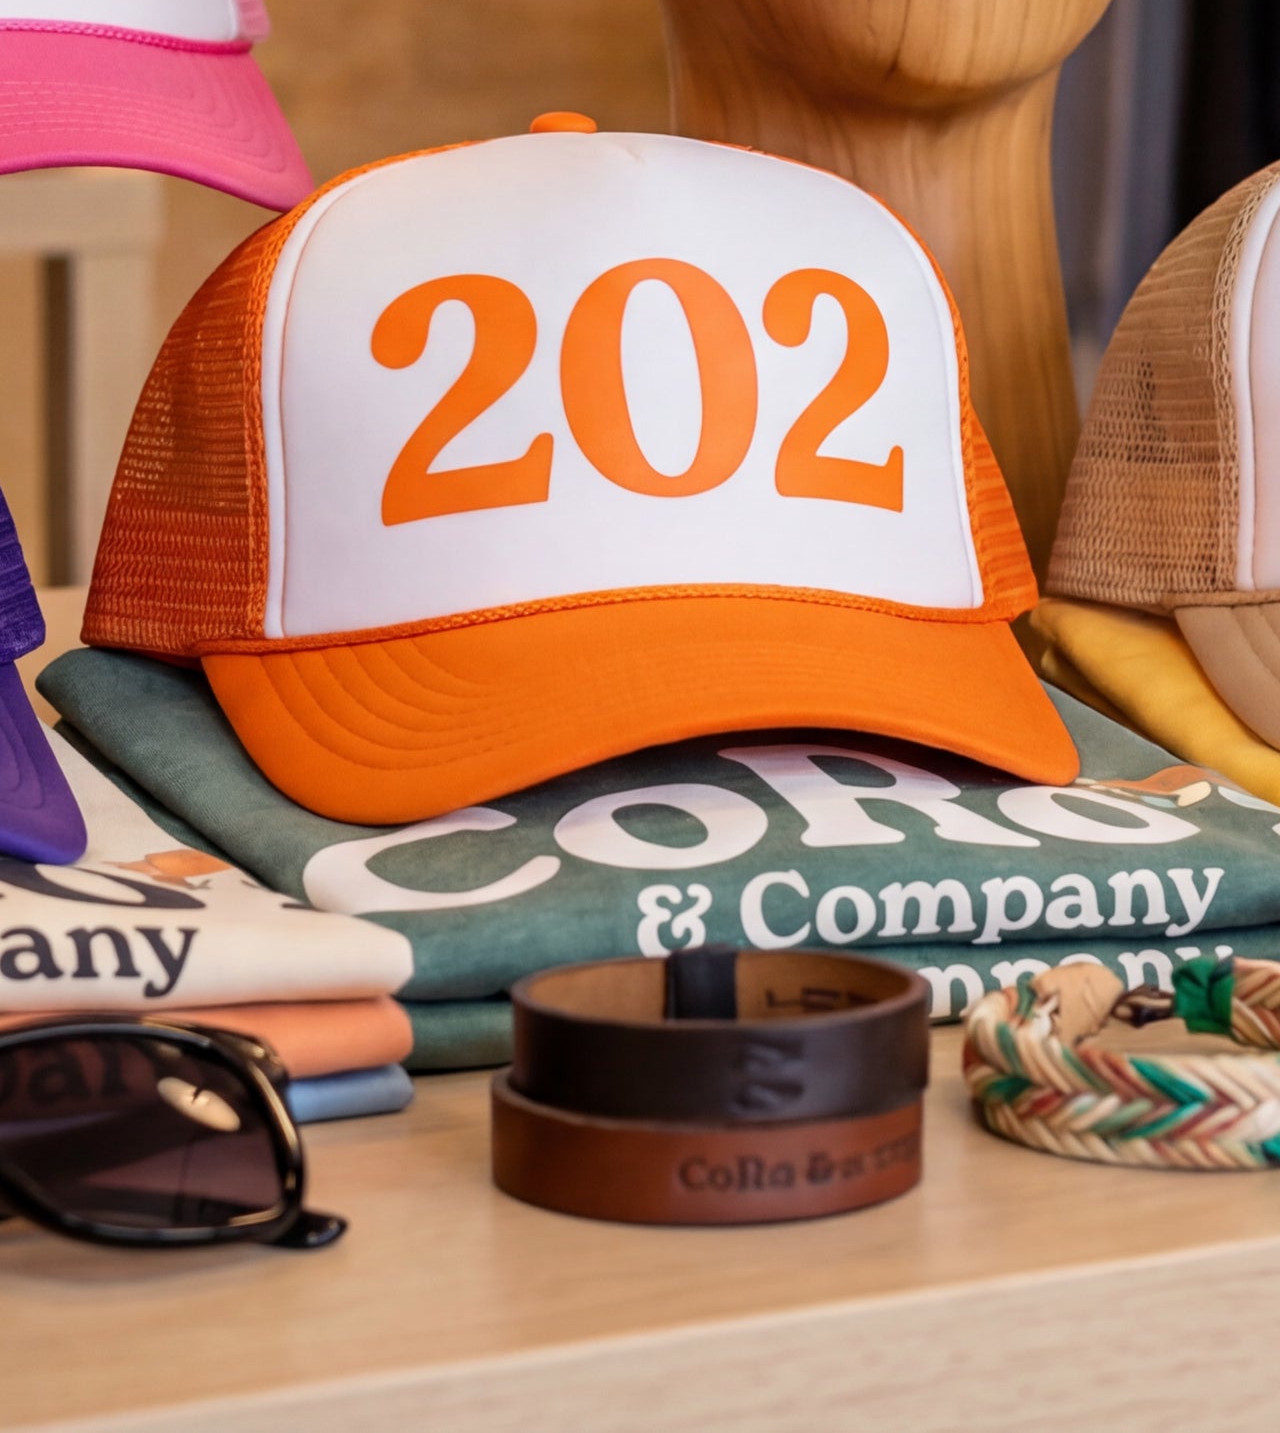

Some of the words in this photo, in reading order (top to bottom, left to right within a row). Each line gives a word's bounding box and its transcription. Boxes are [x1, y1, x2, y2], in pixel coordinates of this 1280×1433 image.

[369, 257, 904, 528] 202
[637, 883, 713, 959] &
[740, 866, 1224, 950] Company
